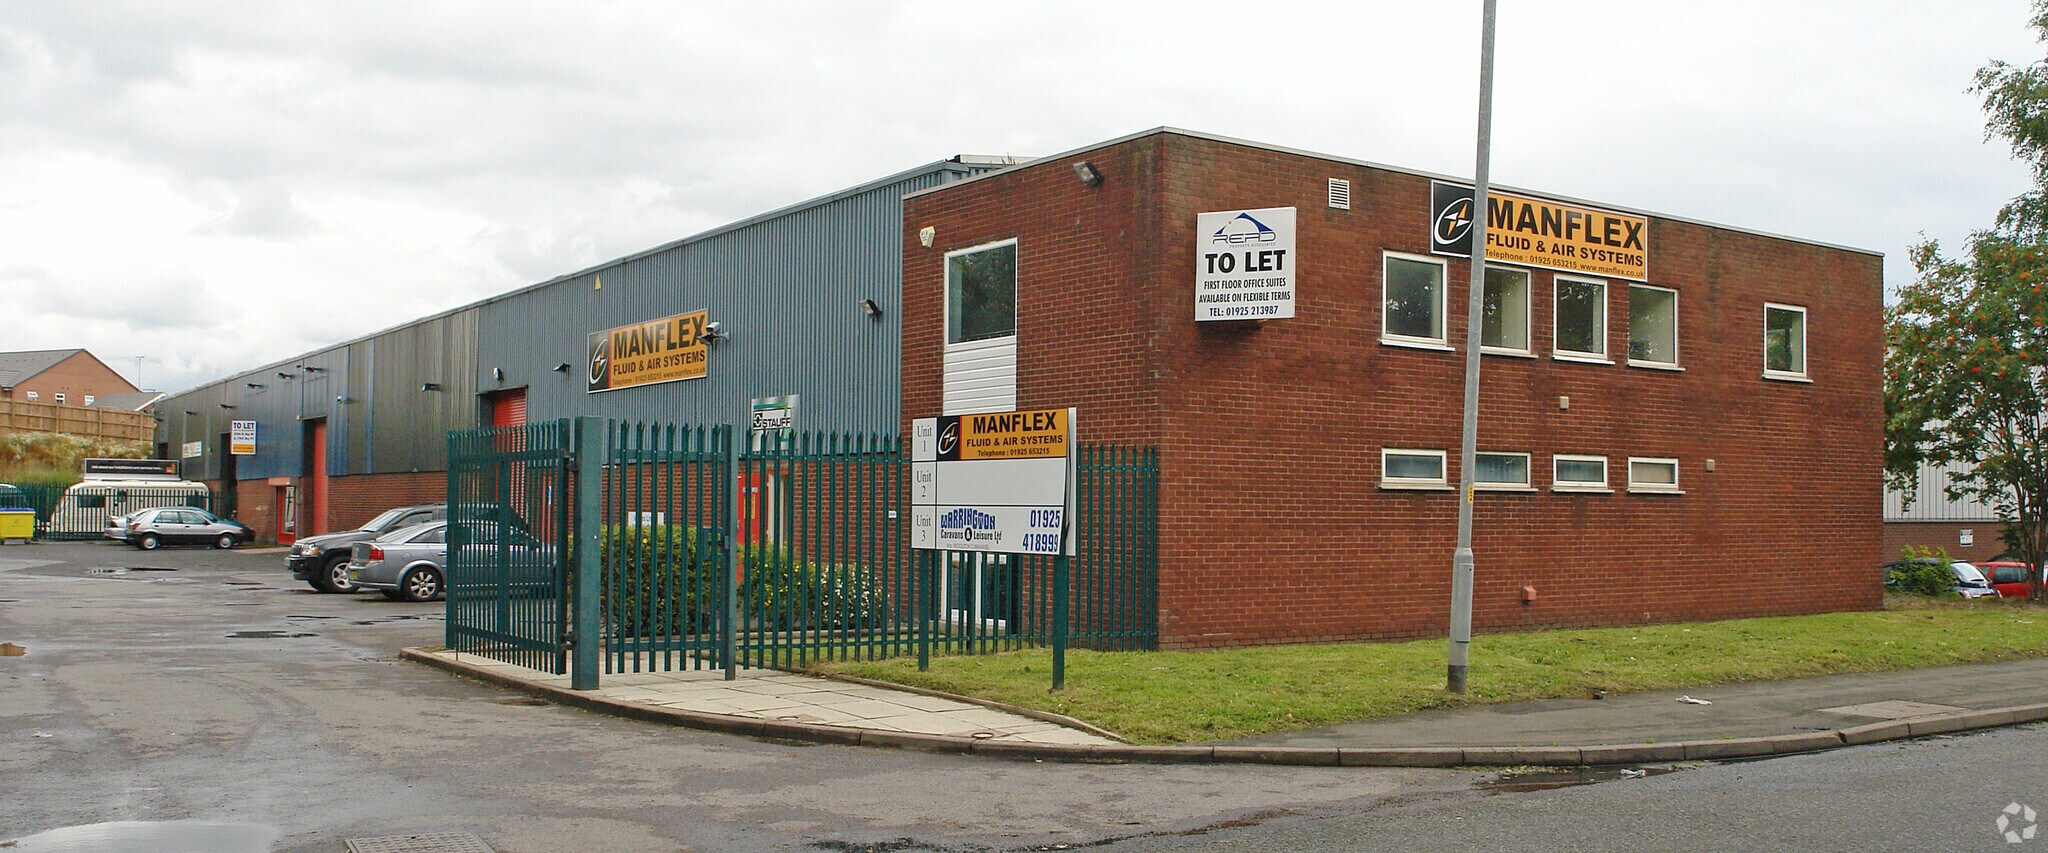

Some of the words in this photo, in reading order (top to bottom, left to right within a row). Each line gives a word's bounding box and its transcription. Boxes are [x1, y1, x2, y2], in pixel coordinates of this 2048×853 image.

[1487, 197, 1644, 251] MANFLEX
[1212, 232, 1276, 244] READ
[1486, 233, 1530, 250] FLUID
[1536, 241, 1546, 253] &
[1551, 243, 1576, 257] AIR
[1580, 247, 1643, 267] SYSTEMS
[1205, 252, 1235, 274] TO
[1245, 250, 1286, 272] LET
[1485, 249, 1524, 262] Telephone
[1529, 255, 1551, 265] 01925
[1552, 258, 1577, 269] 653215
[1579, 263, 1644, 278] www.manflex.co.uk
[1204, 280, 1220, 290] FIRST
[1222, 279, 1242, 289] FLOOR
[1244, 278, 1264, 288] OFFICE
[1266, 277, 1286, 287] SUITES
[1199, 293, 1230, 303] AVAILABLE
[1232, 293, 1242, 302] ON
[1243, 292, 1270, 302] FLEXIBLE
[1271, 291, 1290, 301] TERMS
[1210, 308, 1224, 316] TEL:
[1226, 307, 1249, 316] 01925
[1252, 306, 1278, 315] 213987
[614, 315, 706, 360] MANFLEX
[613, 362, 636, 375] FLUID
[638, 362, 644, 372] &
[647, 358, 661, 370] AIR
[663, 350, 705, 368] SYSTEMS
[762, 418, 791, 427] STAUFF
[972, 412, 1057, 434] MANFLEX
[917, 426, 932, 437] Unit
[923, 441, 926, 452] 1
[966, 439, 990, 447] FLUID
[1002, 437, 1018, 446] AIR
[1021, 435, 1063, 445] SYSTEMS
[916, 471, 932, 482] Unit
[922, 487, 926, 498] 2
[916, 515, 932, 526] Unit
[941, 508, 996, 530] WARRINGTON
[1030, 510, 1060, 528] 01925
[921, 531, 926, 542] 3
[941, 529, 963, 539] Caravans
[974, 530, 993, 540] Leisure
[1023, 533, 1058, 552] 418999
